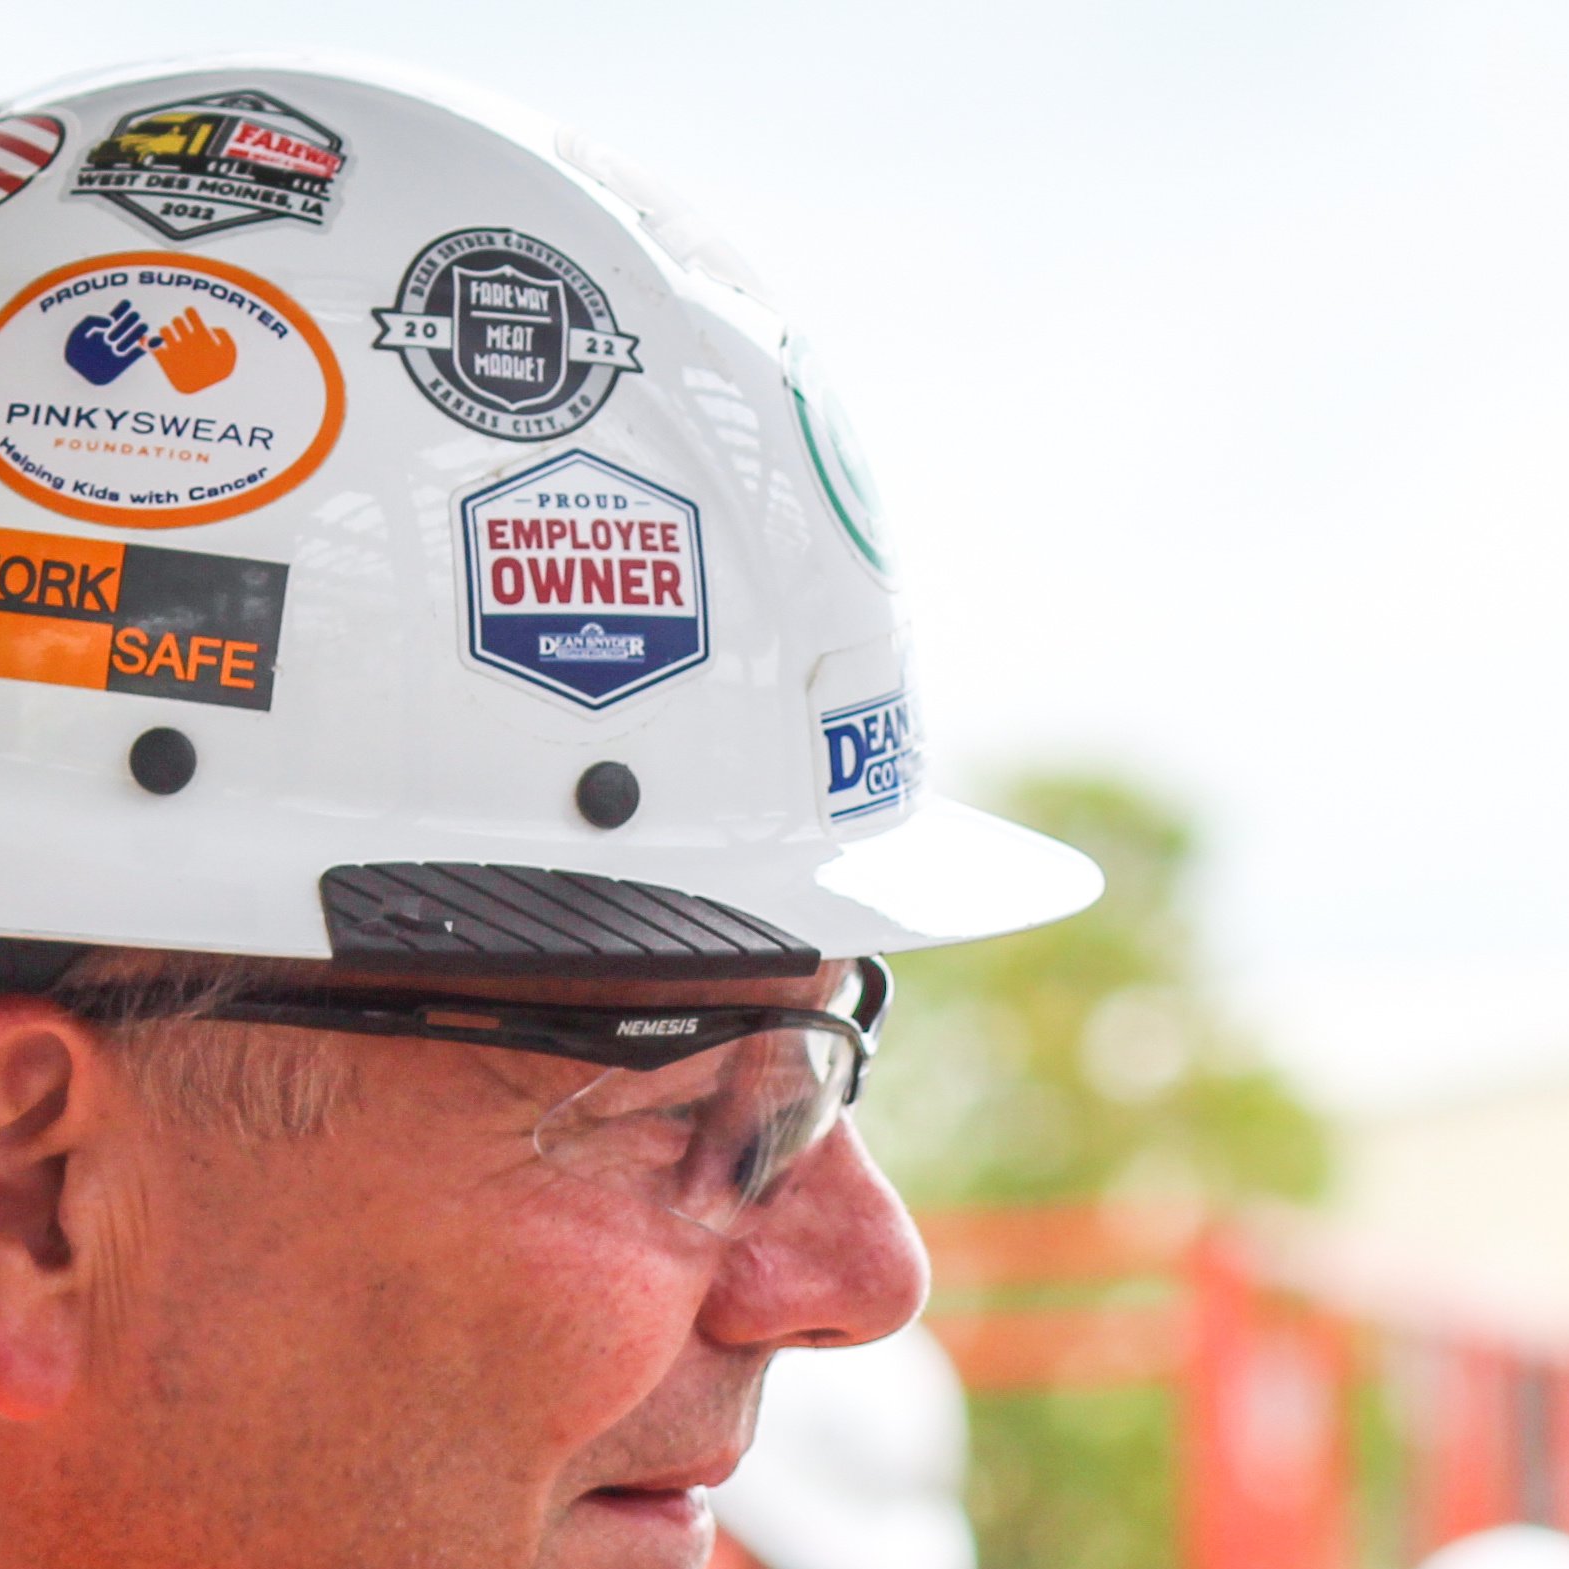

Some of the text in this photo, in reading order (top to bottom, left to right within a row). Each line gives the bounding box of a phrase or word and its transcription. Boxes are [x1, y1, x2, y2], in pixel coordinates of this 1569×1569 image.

[78, 173, 323, 217] WEST DES MOINES, IA
[160, 203, 215, 221] 2022
[39, 270, 289, 340] PROUD SUPPORTER
[470, 281, 549, 312] FAREWAY
[404, 321, 615, 356] 20 22
[486, 325, 535, 352] MEAT
[474, 353, 545, 382] MARKET
[428, 377, 499, 429] KANSAS
[6, 402, 275, 451] PINKYSWEAR
[53, 438, 211, 464] FOUNDATION
[72, 480, 120, 502] Kids
[130, 490, 179, 504] with
[189, 466, 269, 501] Cancer
[538, 493, 628, 510] PROUD
[487, 518, 681, 553] EMPLOYEE
[491, 556, 685, 607] OWNER
[112, 626, 259, 691] SAFE
[823, 702, 910, 794] DEAN
[616, 1018, 699, 1037] NEMESIS
